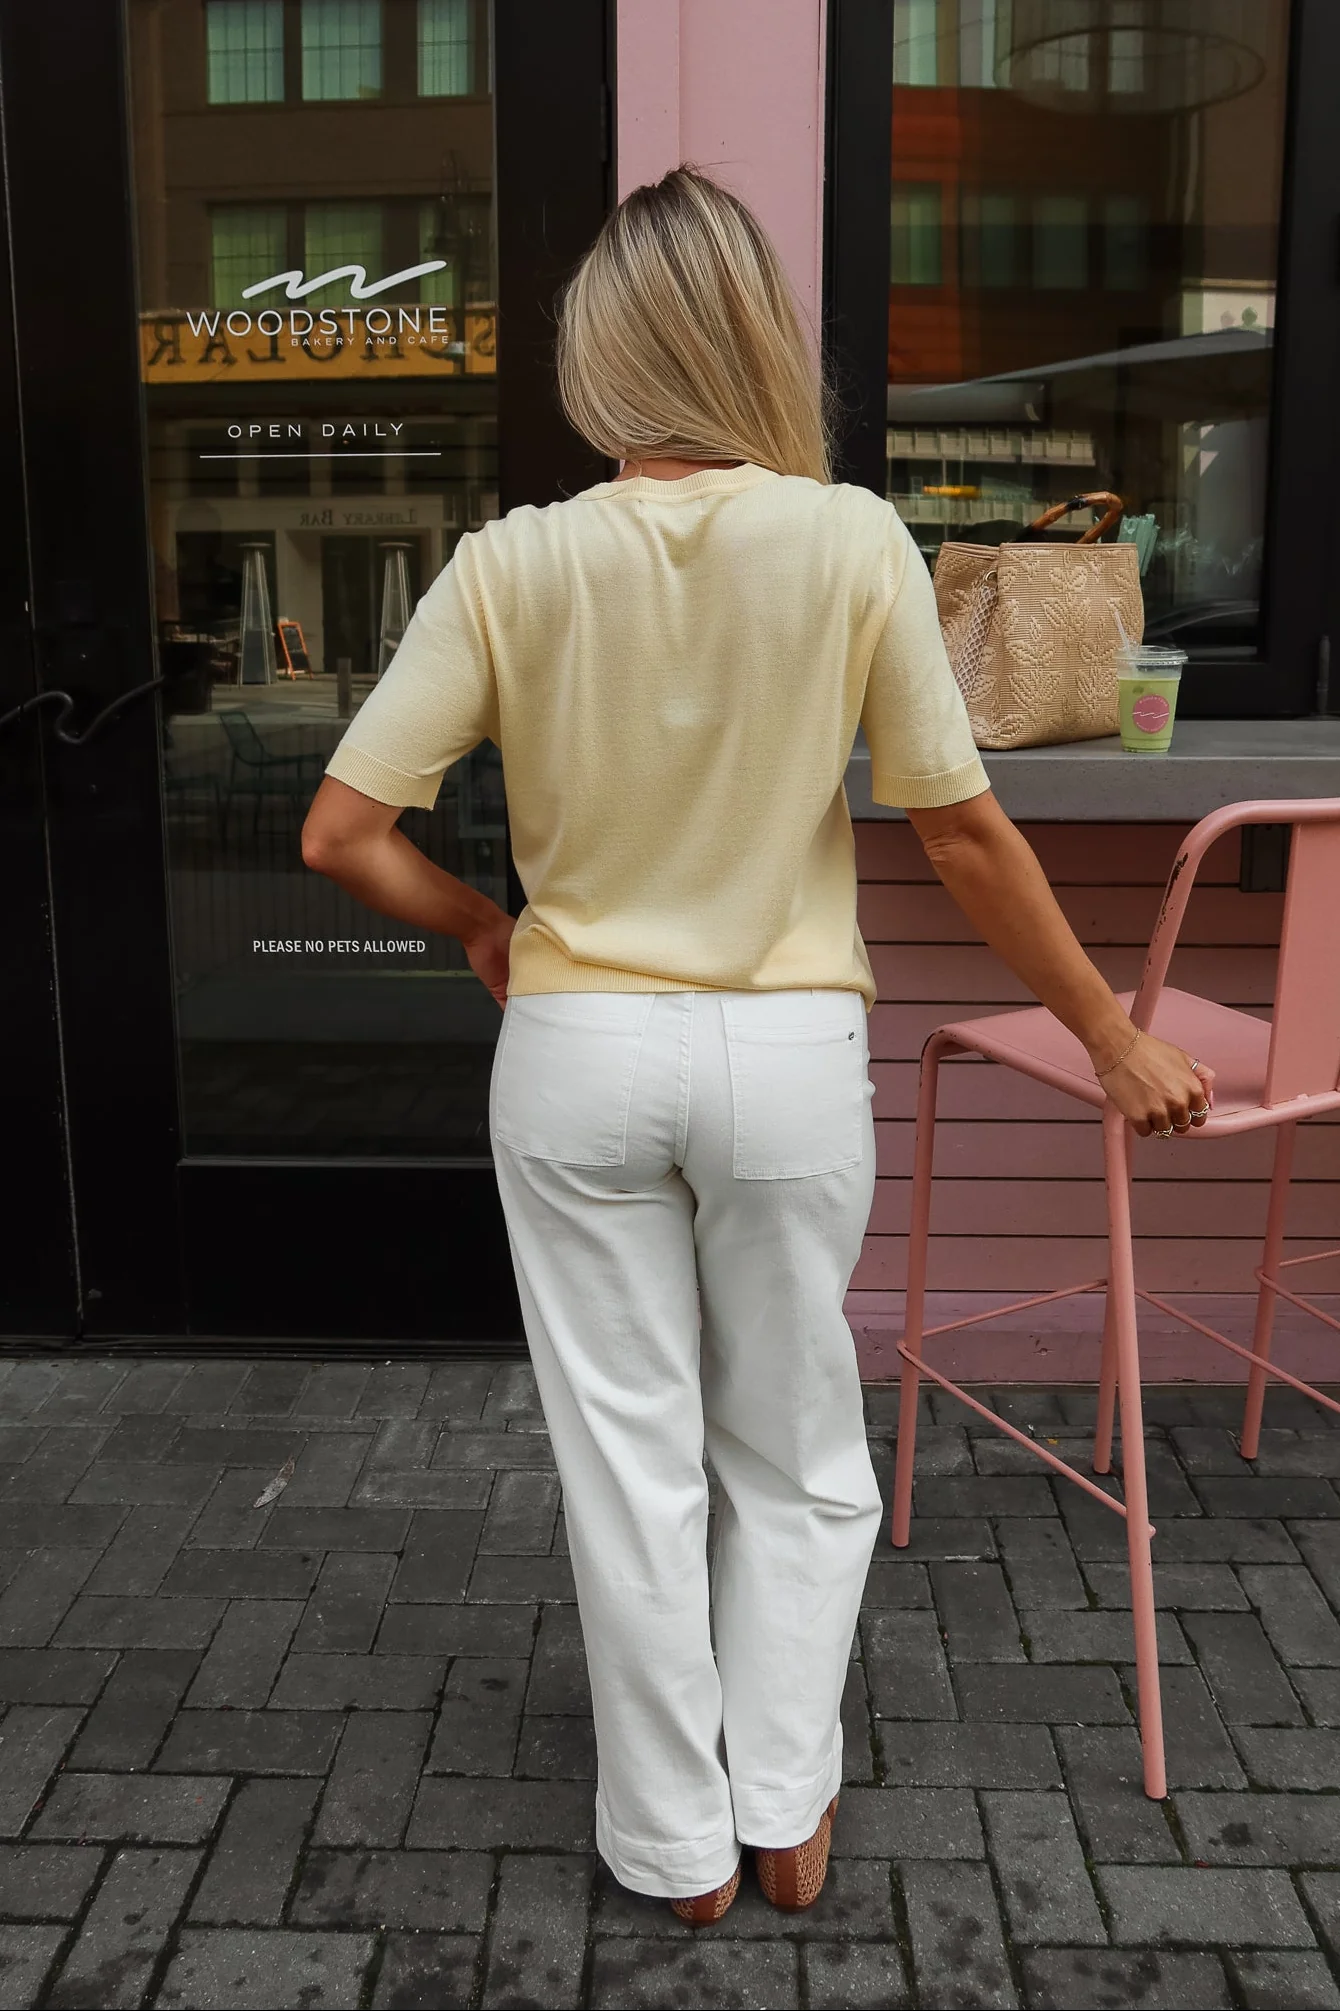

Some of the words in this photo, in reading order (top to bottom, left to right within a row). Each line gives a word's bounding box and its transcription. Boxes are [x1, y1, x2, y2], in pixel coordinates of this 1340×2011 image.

[186, 307, 448, 338] WOODSTONE
[291, 337, 354, 347] BAKERY
[365, 336, 397, 345] AND
[407, 335, 449, 345] CAFE
[227, 424, 302, 438] OPEN
[322, 422, 403, 437] DAILY
[252, 940, 302, 953] PLEASE
[305, 940, 324, 953] NO
[328, 940, 360, 953] PETS
[363, 940, 426, 953] ALLOWED
